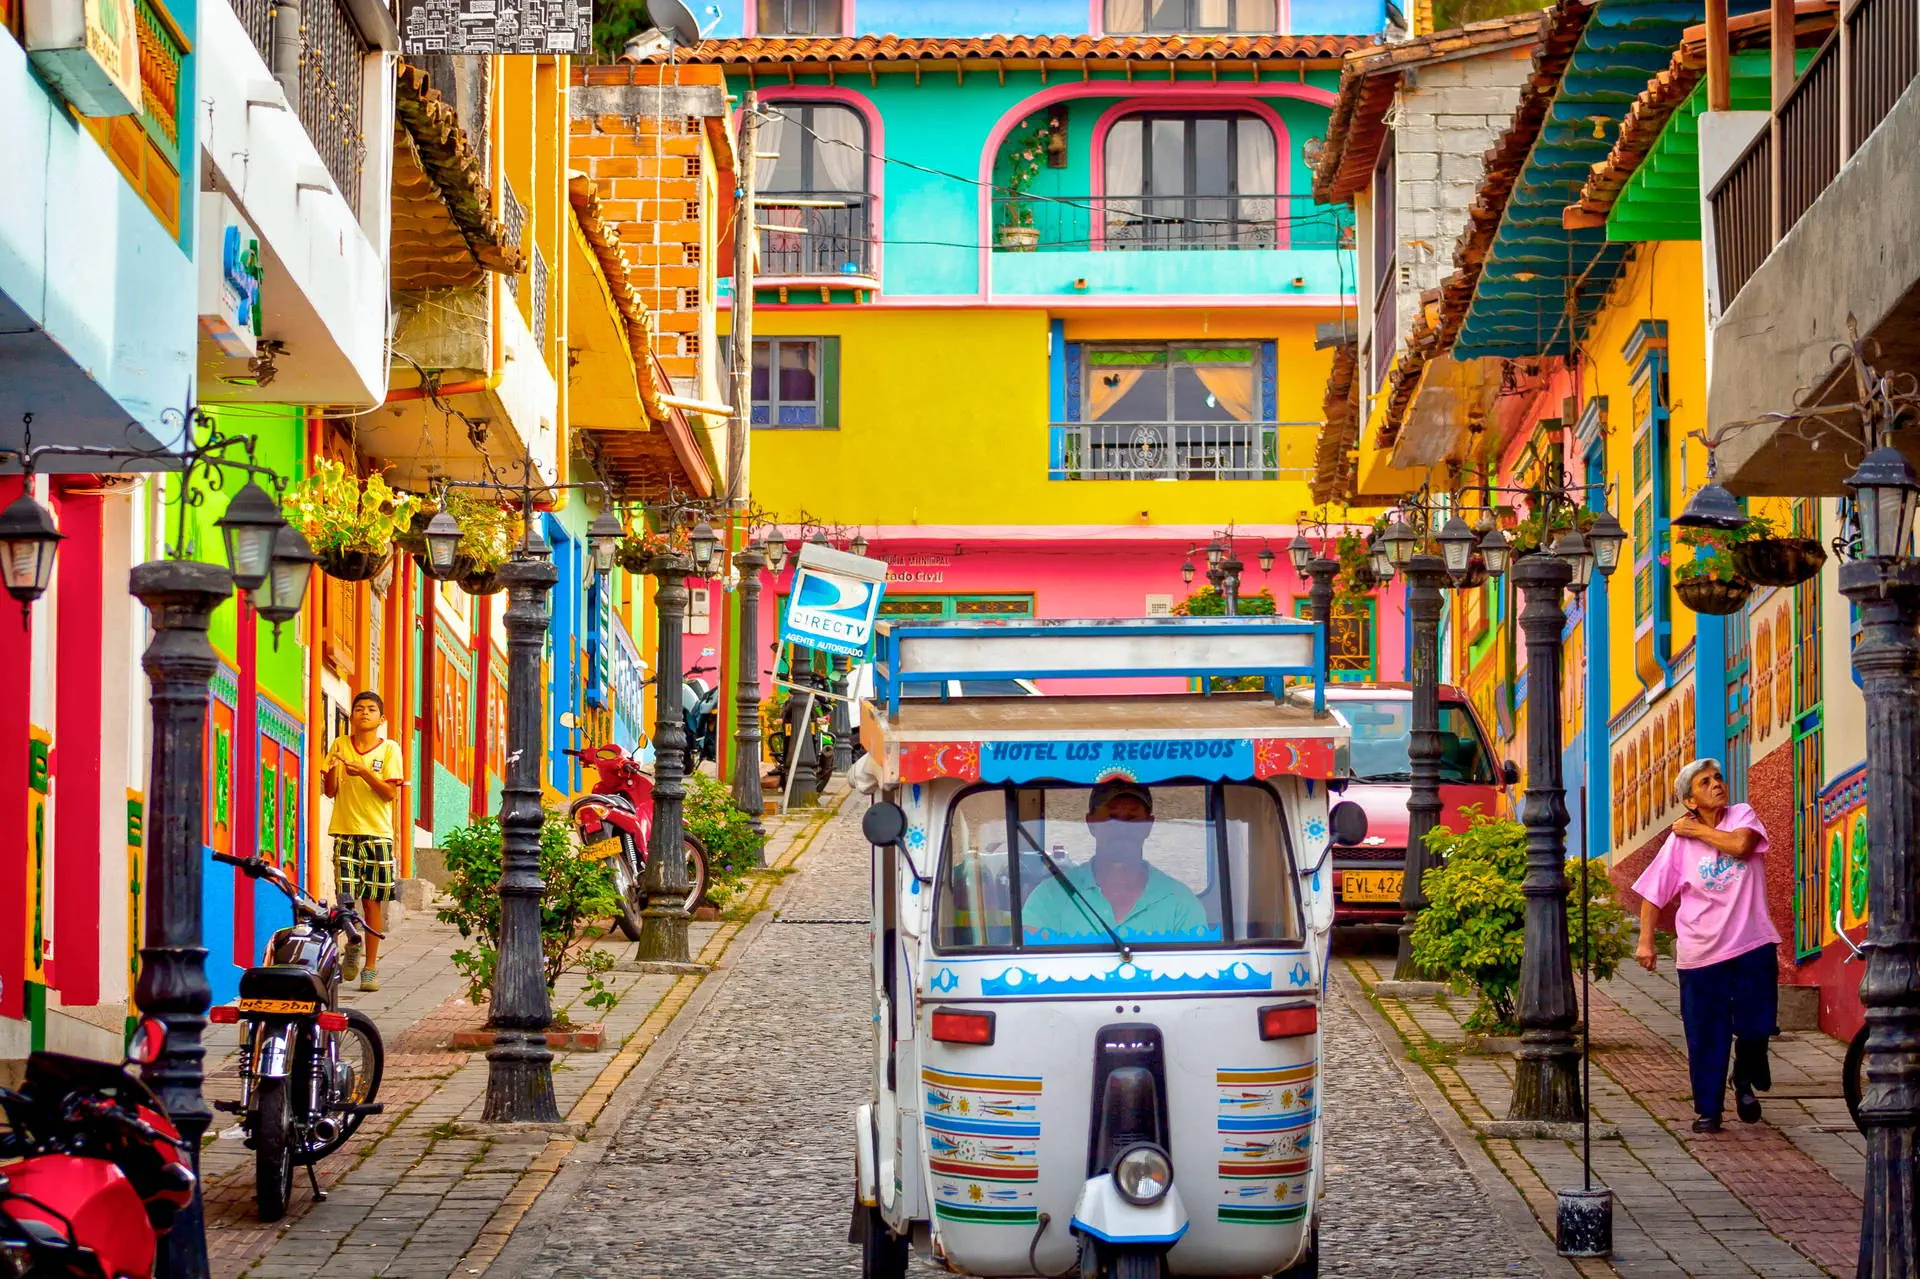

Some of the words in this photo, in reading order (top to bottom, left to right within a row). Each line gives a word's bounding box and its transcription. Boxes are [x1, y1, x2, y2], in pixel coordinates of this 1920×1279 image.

[885, 571, 914, 582] tado
[915, 570, 943, 583] Civil
[793, 611, 865, 638] DIRECTV
[785, 632, 816, 647] AGENTE
[816, 640, 864, 658] AUTORIZADO
[992, 742, 1058, 761] HOTEL
[1065, 742, 1103, 761] LOS
[1111, 739, 1237, 761] RECUERDOS
[1345, 877, 1373, 894] EVL
